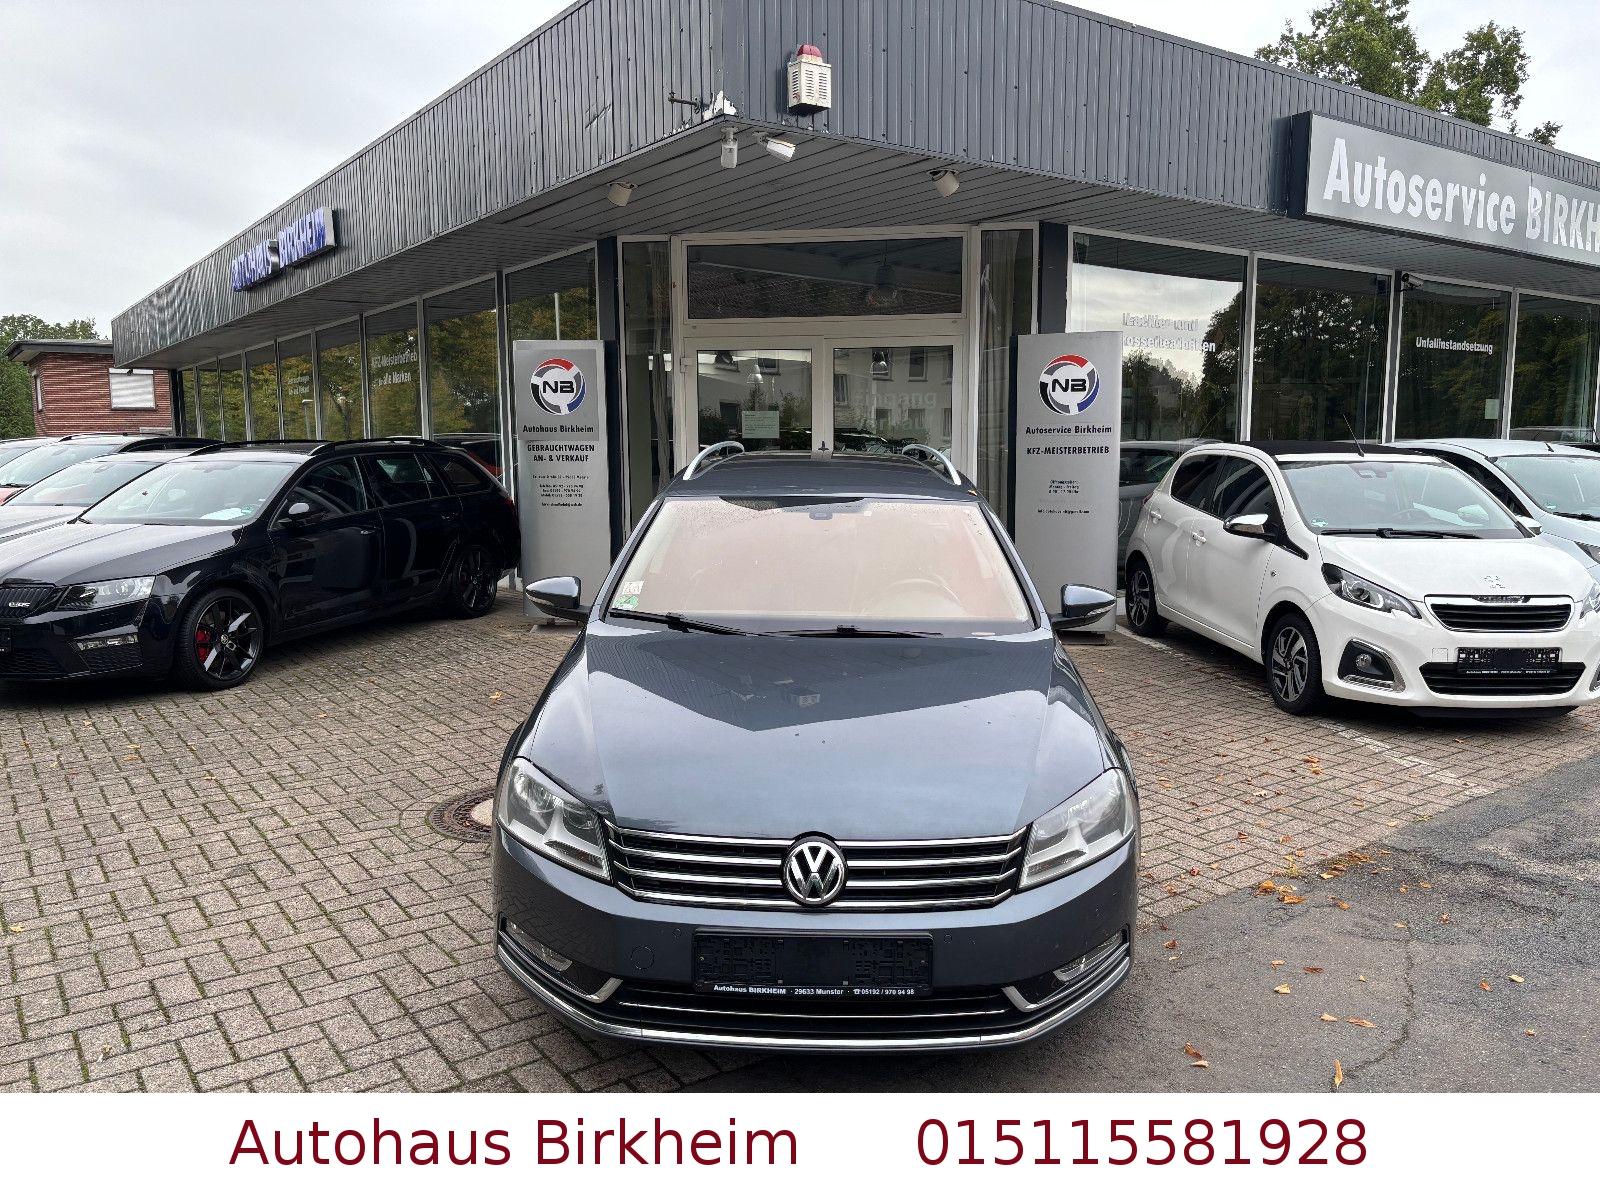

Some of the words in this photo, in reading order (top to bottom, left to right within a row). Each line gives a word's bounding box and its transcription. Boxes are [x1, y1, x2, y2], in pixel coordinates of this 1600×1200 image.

[1323, 137, 1516, 235] Autoservice
[1416, 336, 1493, 355] Unfallinstandsetzung
[542, 380, 575, 394] NB
[1051, 378, 1087, 393] NB
[522, 424, 558, 433] Autohaus
[560, 424, 594, 433] Birkheim
[1025, 426, 1072, 435] Autoservice
[1074, 425, 1112, 434] Birkheim
[527, 444, 595, 452] GEBRAUCHTWAGEN
[1026, 446, 1110, 455] KFZ-MEISTERBETRIEB
[713, 984, 747, 993] Autohaus
[748, 986, 787, 995] BIRKHEIM
